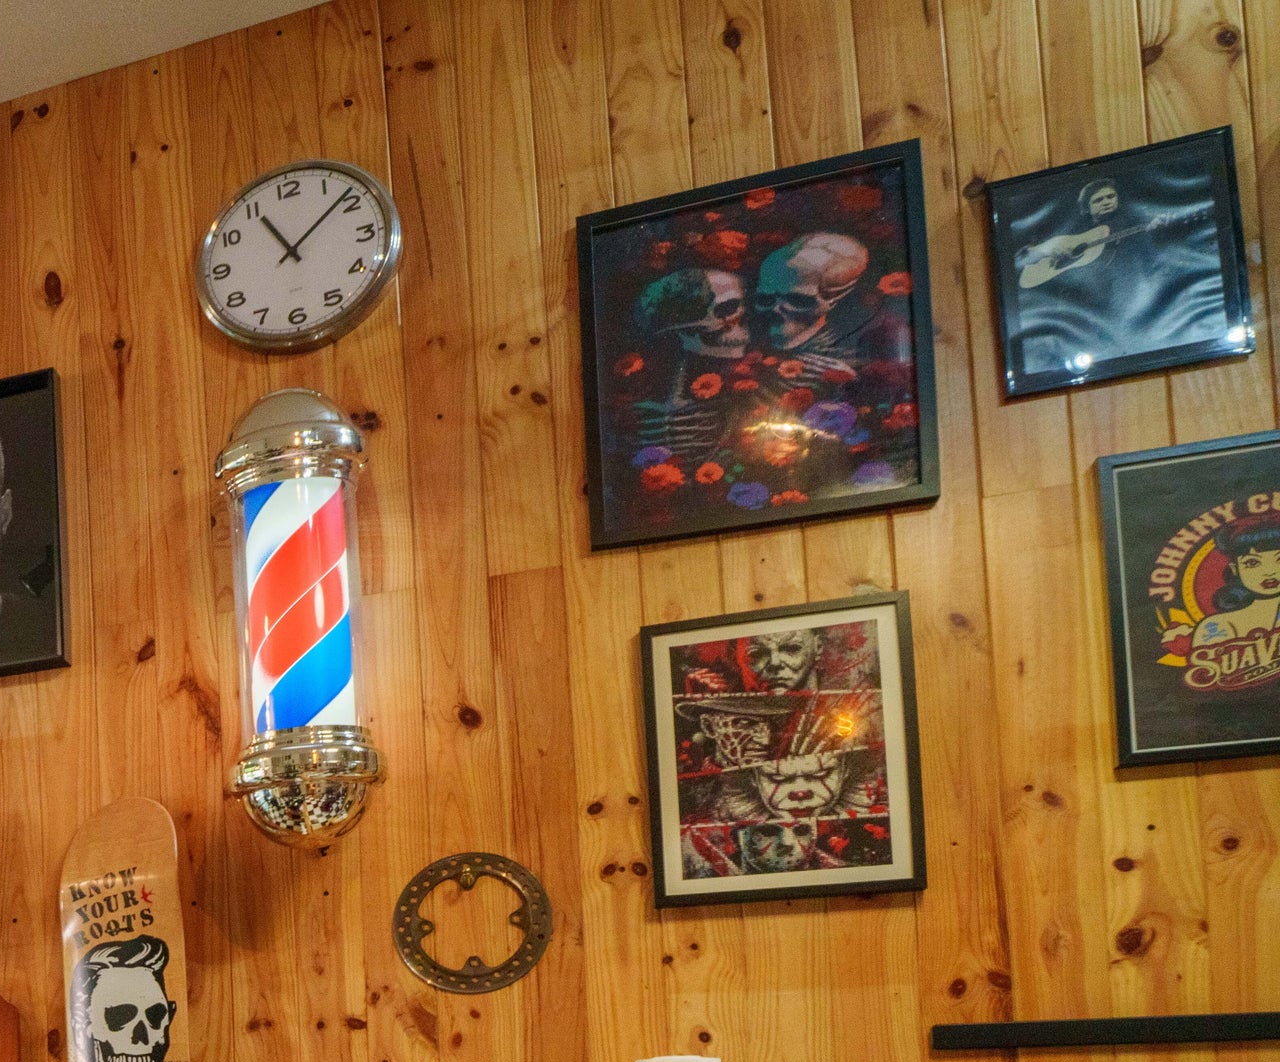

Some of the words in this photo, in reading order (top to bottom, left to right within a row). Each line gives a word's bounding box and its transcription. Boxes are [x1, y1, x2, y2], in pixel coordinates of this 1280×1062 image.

[277, 180, 301, 201] 12
[321, 178, 327, 195] 1
[246, 201, 260, 220] 11
[342, 194, 362, 214] 2
[222, 229, 241, 248] 10
[355, 222, 376, 243] 3
[212, 263, 232, 281] 9
[347, 257, 366, 275] 4
[226, 291, 247, 308] 8
[323, 288, 344, 307] 5
[253, 307, 270, 326] 7
[287, 307, 308, 325] 6
[1149, 500, 1237, 602] JOHNNY
[1185, 633, 1280, 688] SUAV
[69, 866, 138, 903] KNOW
[76, 889, 140, 925] YOUR
[73, 908, 155, 949] ROOTS
